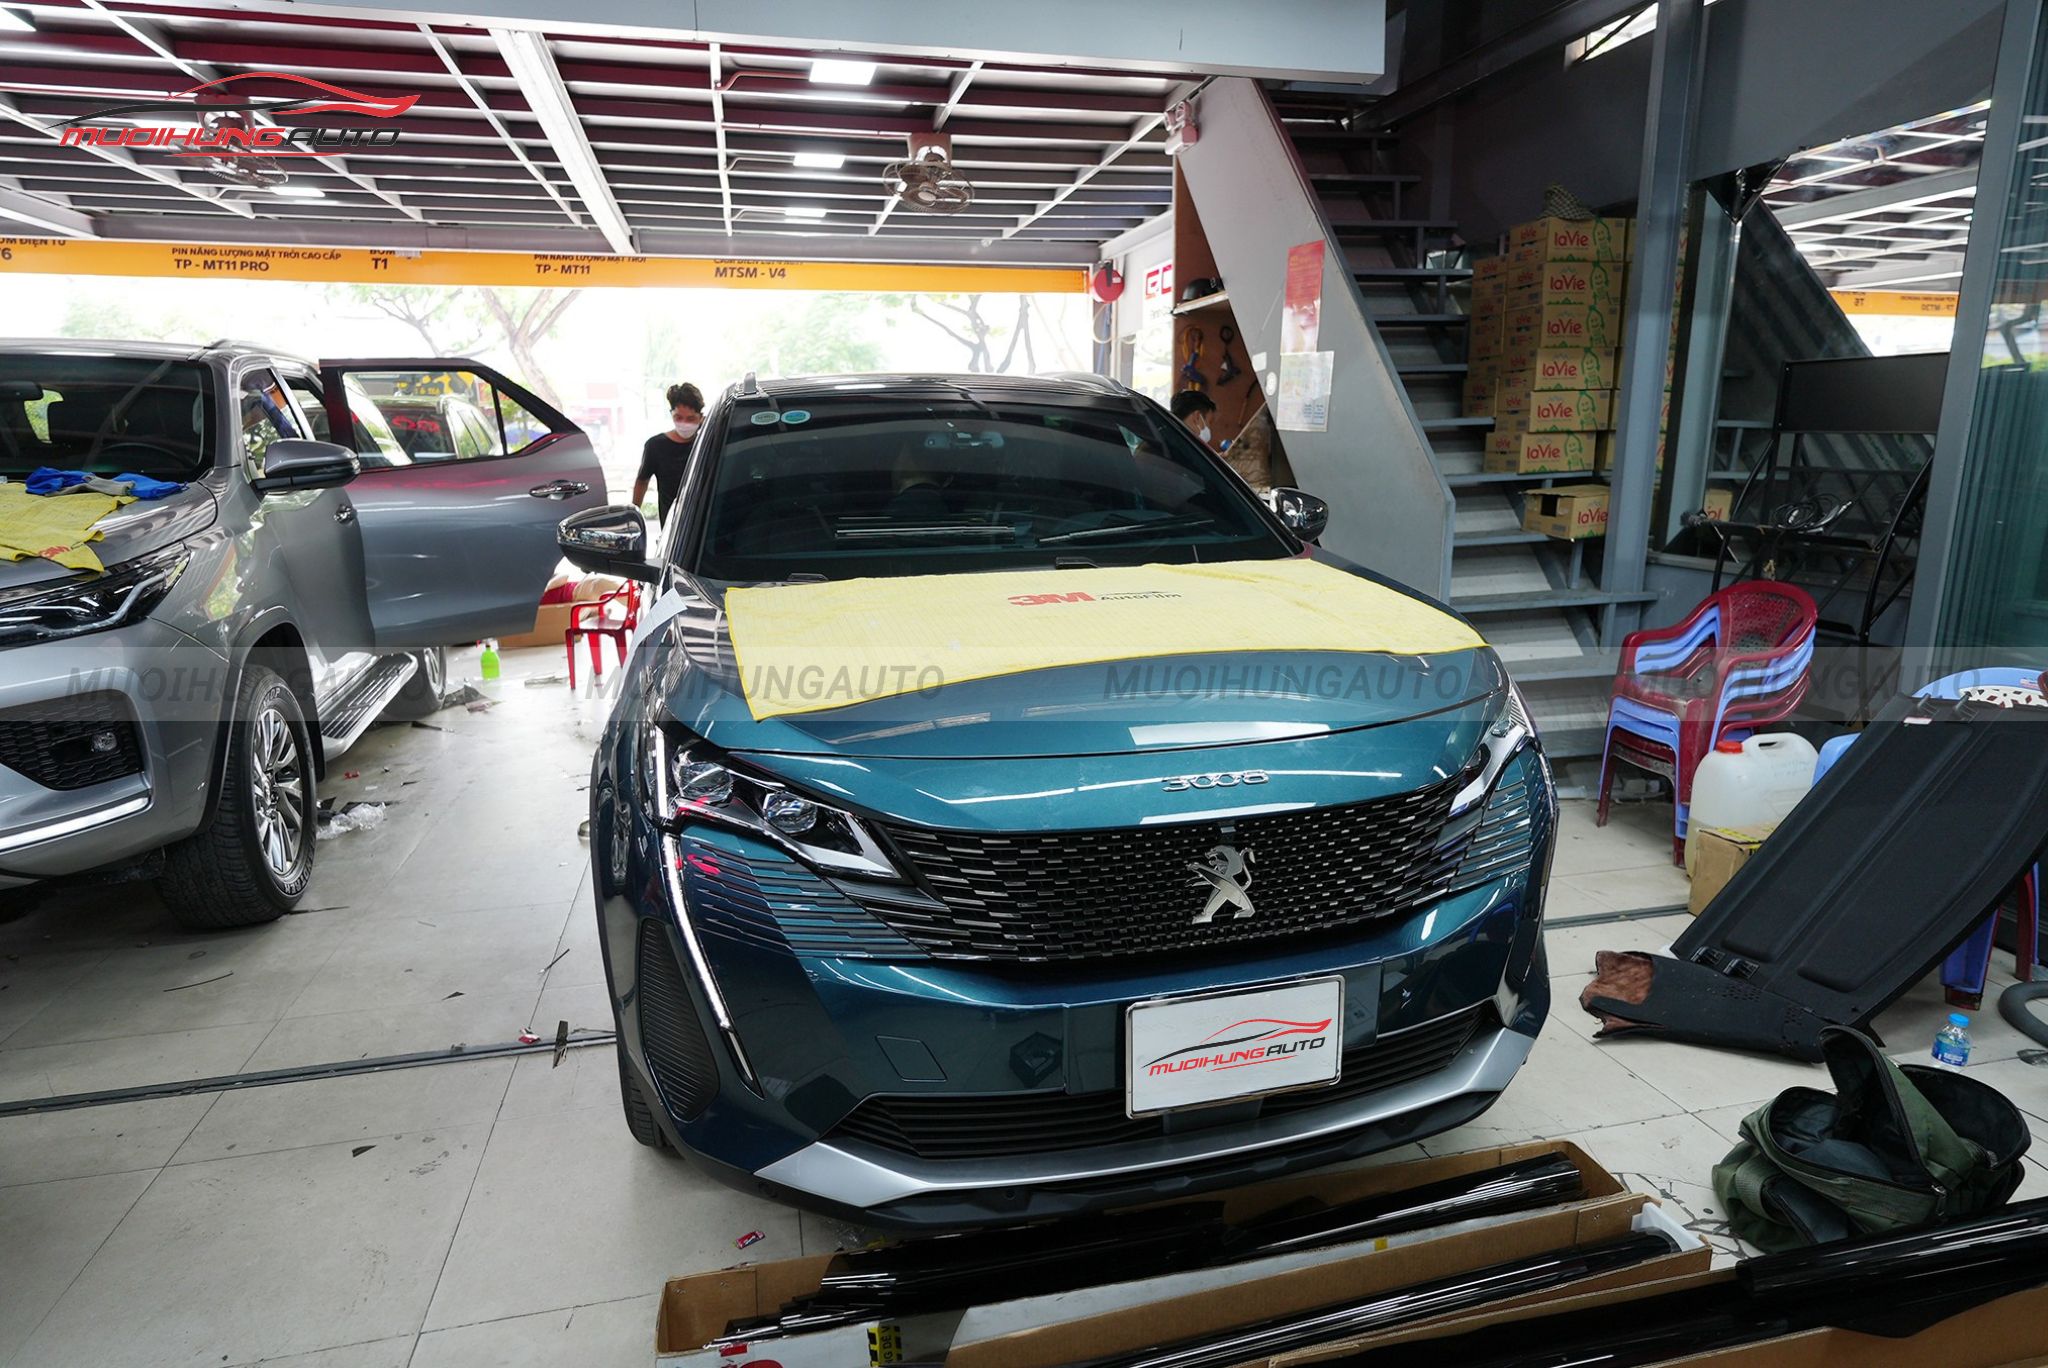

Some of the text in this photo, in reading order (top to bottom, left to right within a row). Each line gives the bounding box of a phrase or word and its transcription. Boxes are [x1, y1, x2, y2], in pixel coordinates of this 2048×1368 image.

[1554, 230, 1590, 247] laVie
[171, 247, 188, 255] PIN
[301, 251, 322, 260] CAO
[174, 258, 192, 270] TP
[202, 259, 238, 271] MT11
[239, 260, 270, 272] PRO
[371, 257, 388, 270] T1
[535, 263, 551, 274] TP
[560, 264, 590, 275] MT11
[714, 266, 758, 278] MTSM
[768, 267, 787, 279] V4
[1550, 274, 1586, 291] laVie
[1546, 318, 1583, 335] laVie
[1542, 360, 1577, 377] laVie
[1537, 402, 1574, 419] laVie
[1526, 444, 1561, 460] laVie
[1577, 508, 1608, 525] laVie
[1007, 591, 1096, 607] 3M
[1160, 768, 1271, 793] 3008
[1148, 1036, 1327, 1077] MUOIHUNGAUTO
